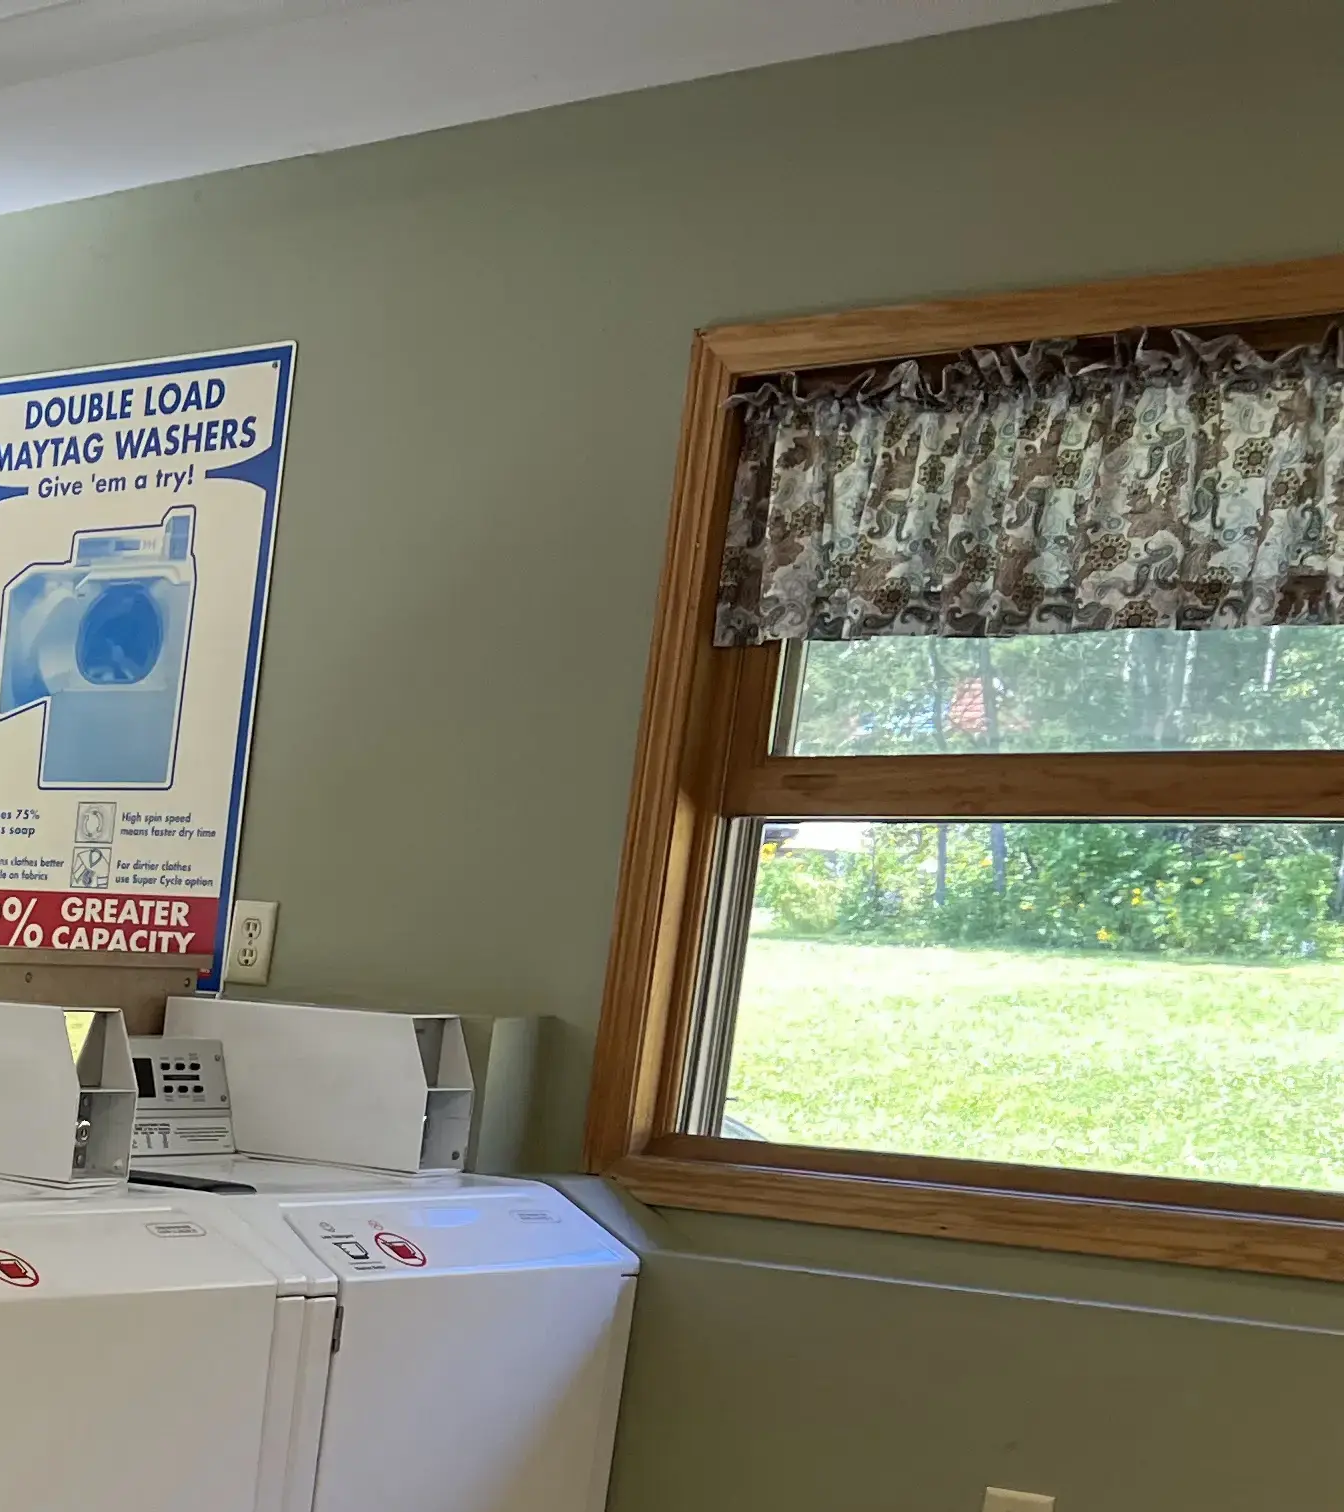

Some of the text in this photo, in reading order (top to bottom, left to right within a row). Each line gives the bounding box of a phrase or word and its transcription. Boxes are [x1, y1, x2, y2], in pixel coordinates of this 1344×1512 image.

[25, 378, 226, 429] DOUBLE LOAD
[115, 416, 257, 460] WASHERS
[38, 464, 194, 498] Give 'em a try!
[15, 809, 40, 820] 75%
[122, 812, 191, 825] High spin speed
[9, 827, 35, 838] soap
[120, 826, 216, 840] means faster dry time
[11, 856, 38, 867] clothes
[40, 856, 64, 867] better
[116, 859, 191, 871] For dirtier clothes
[21, 869, 48, 880] fabrics
[115, 874, 213, 888] use Super Cycle option
[60, 896, 189, 927] GREATER
[51, 927, 195, 954] CAPACITY
